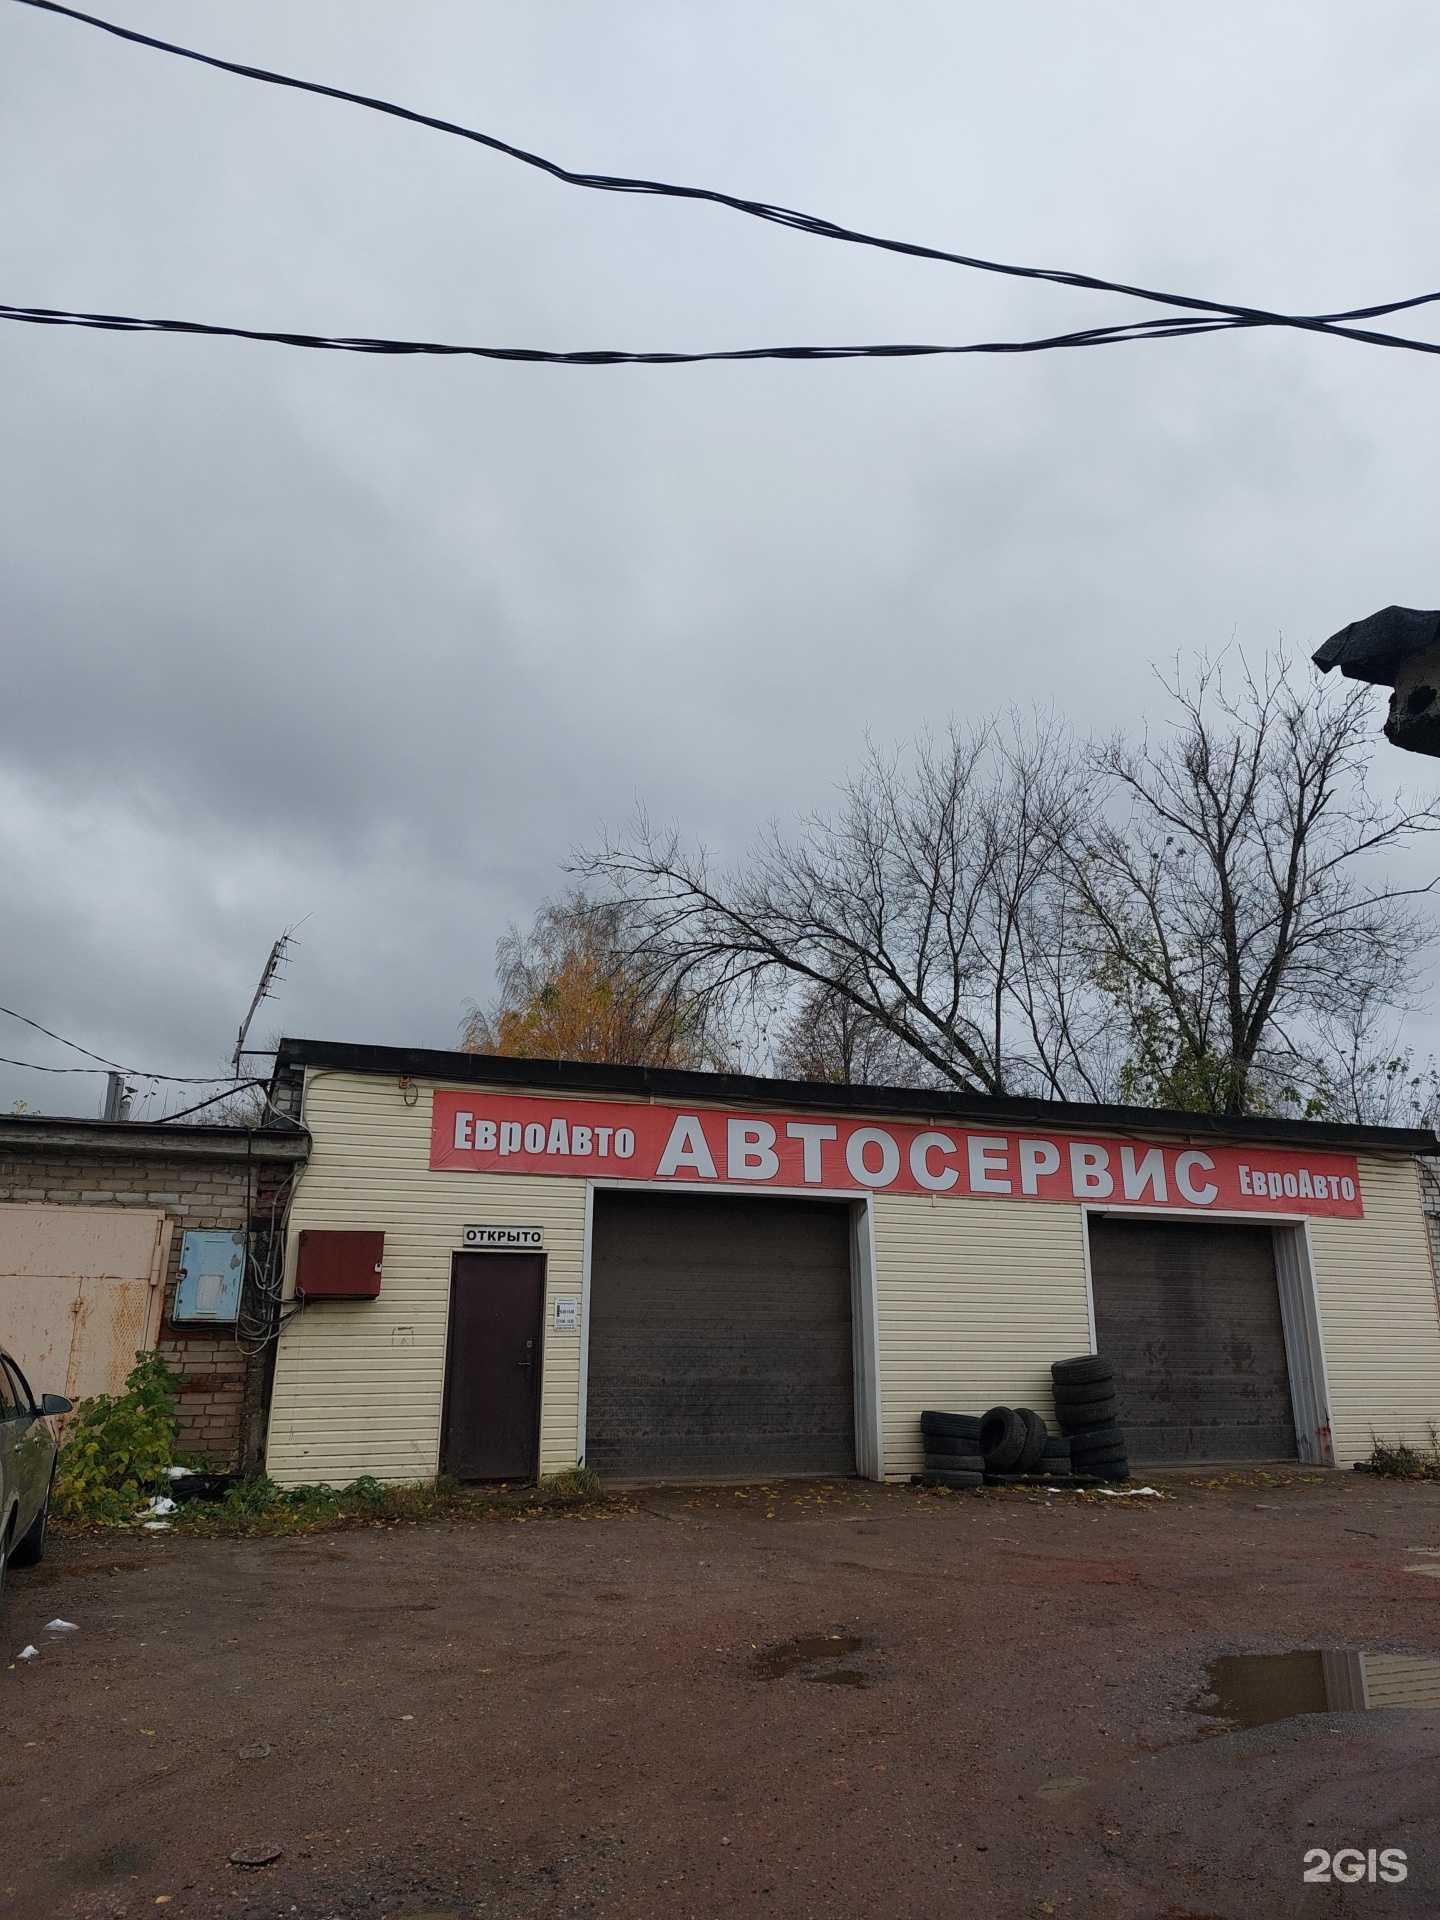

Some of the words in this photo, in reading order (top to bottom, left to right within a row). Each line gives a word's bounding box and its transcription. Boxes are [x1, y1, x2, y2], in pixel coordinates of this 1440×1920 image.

[453, 1111, 636, 1159] ЕвроАвто
[655, 1114, 1219, 1206] АВТОСЕРВИС
[1238, 1164, 1355, 1202] ЕвроАвто
[466, 1230, 542, 1243] ОТКРЫТО
